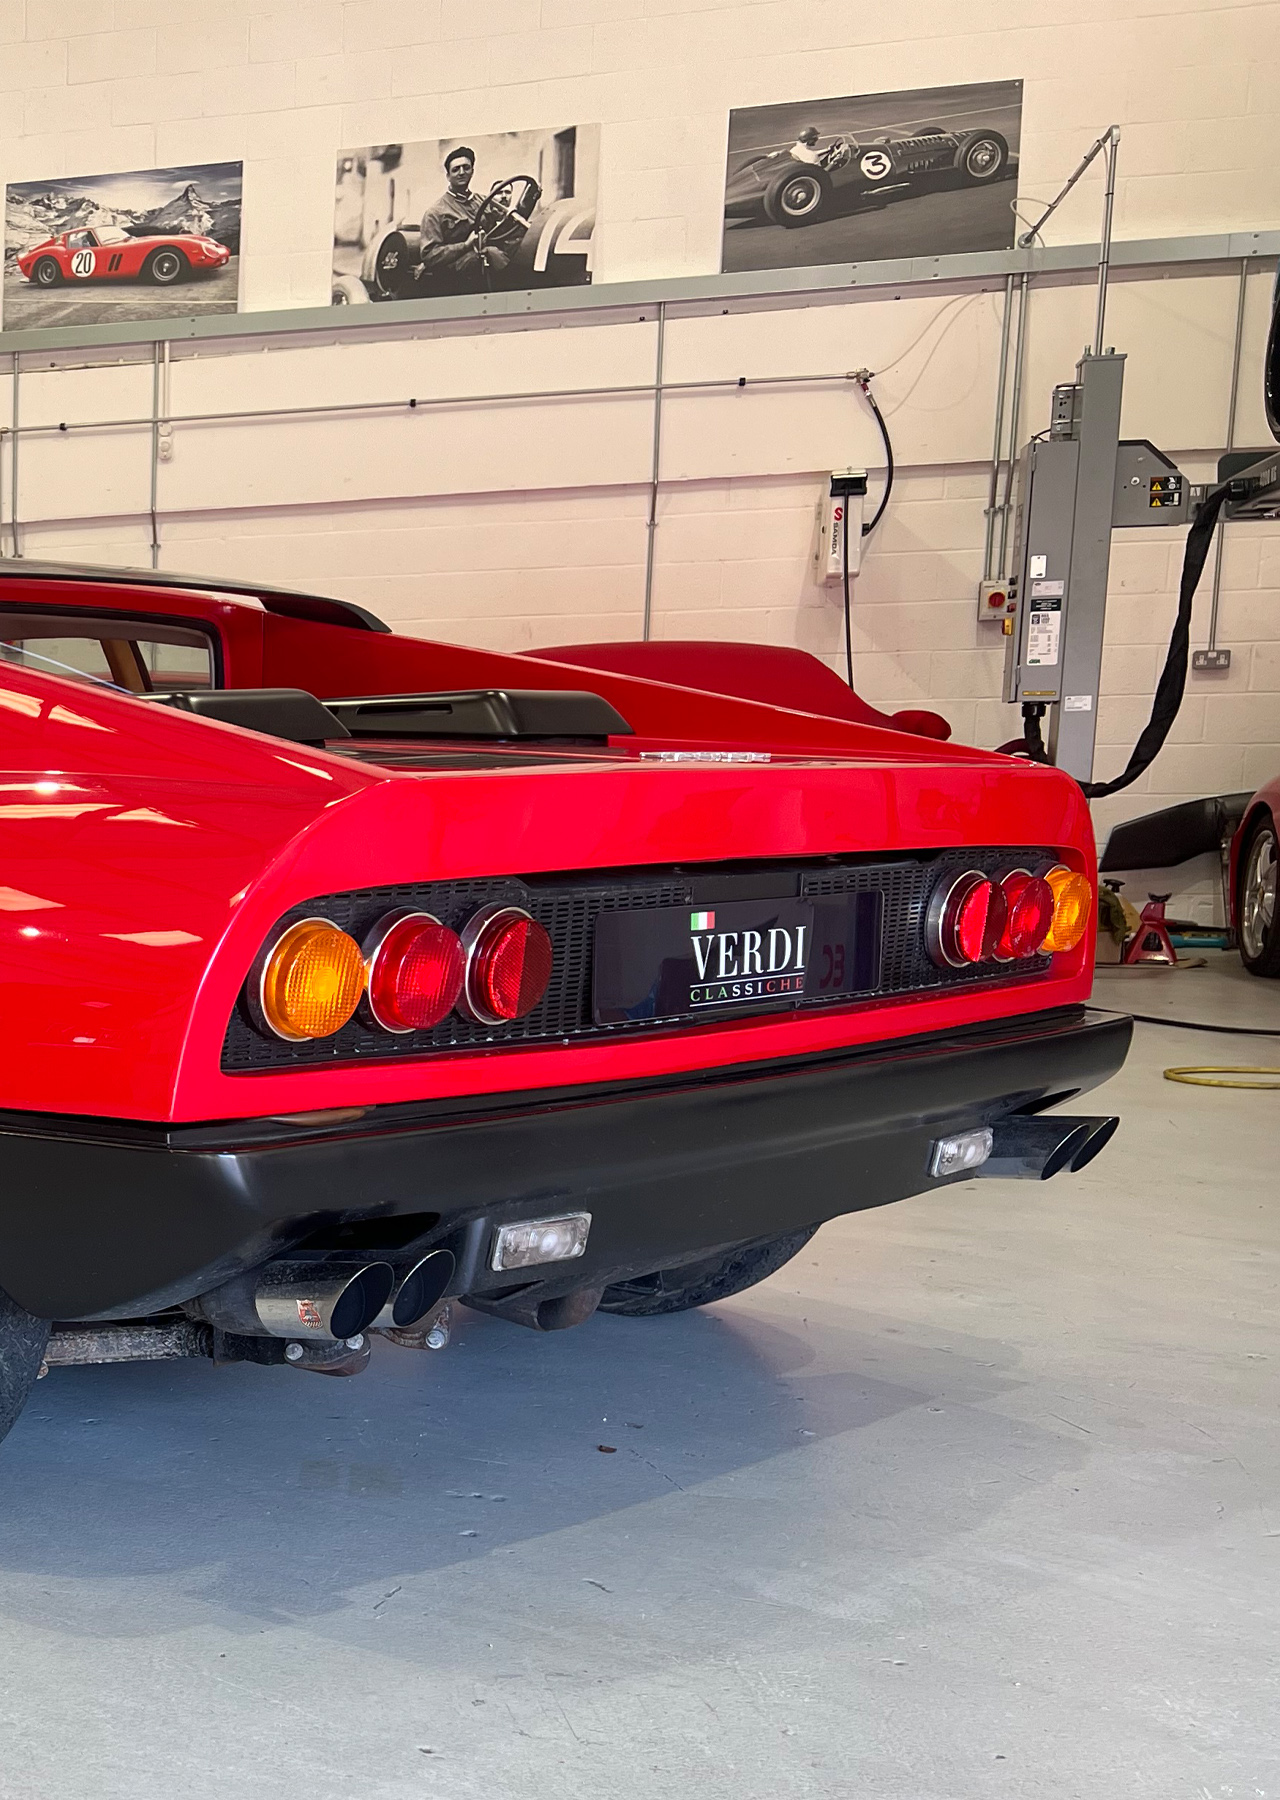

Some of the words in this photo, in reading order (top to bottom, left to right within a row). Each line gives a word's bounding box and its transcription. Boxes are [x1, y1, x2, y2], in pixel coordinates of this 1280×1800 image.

[865, 155, 887, 176] 3
[75, 252, 92, 274] 20
[831, 522, 839, 555] SAMOA
[690, 925, 807, 981] VERDI
[690, 976, 804, 1002] CLASSICHE
